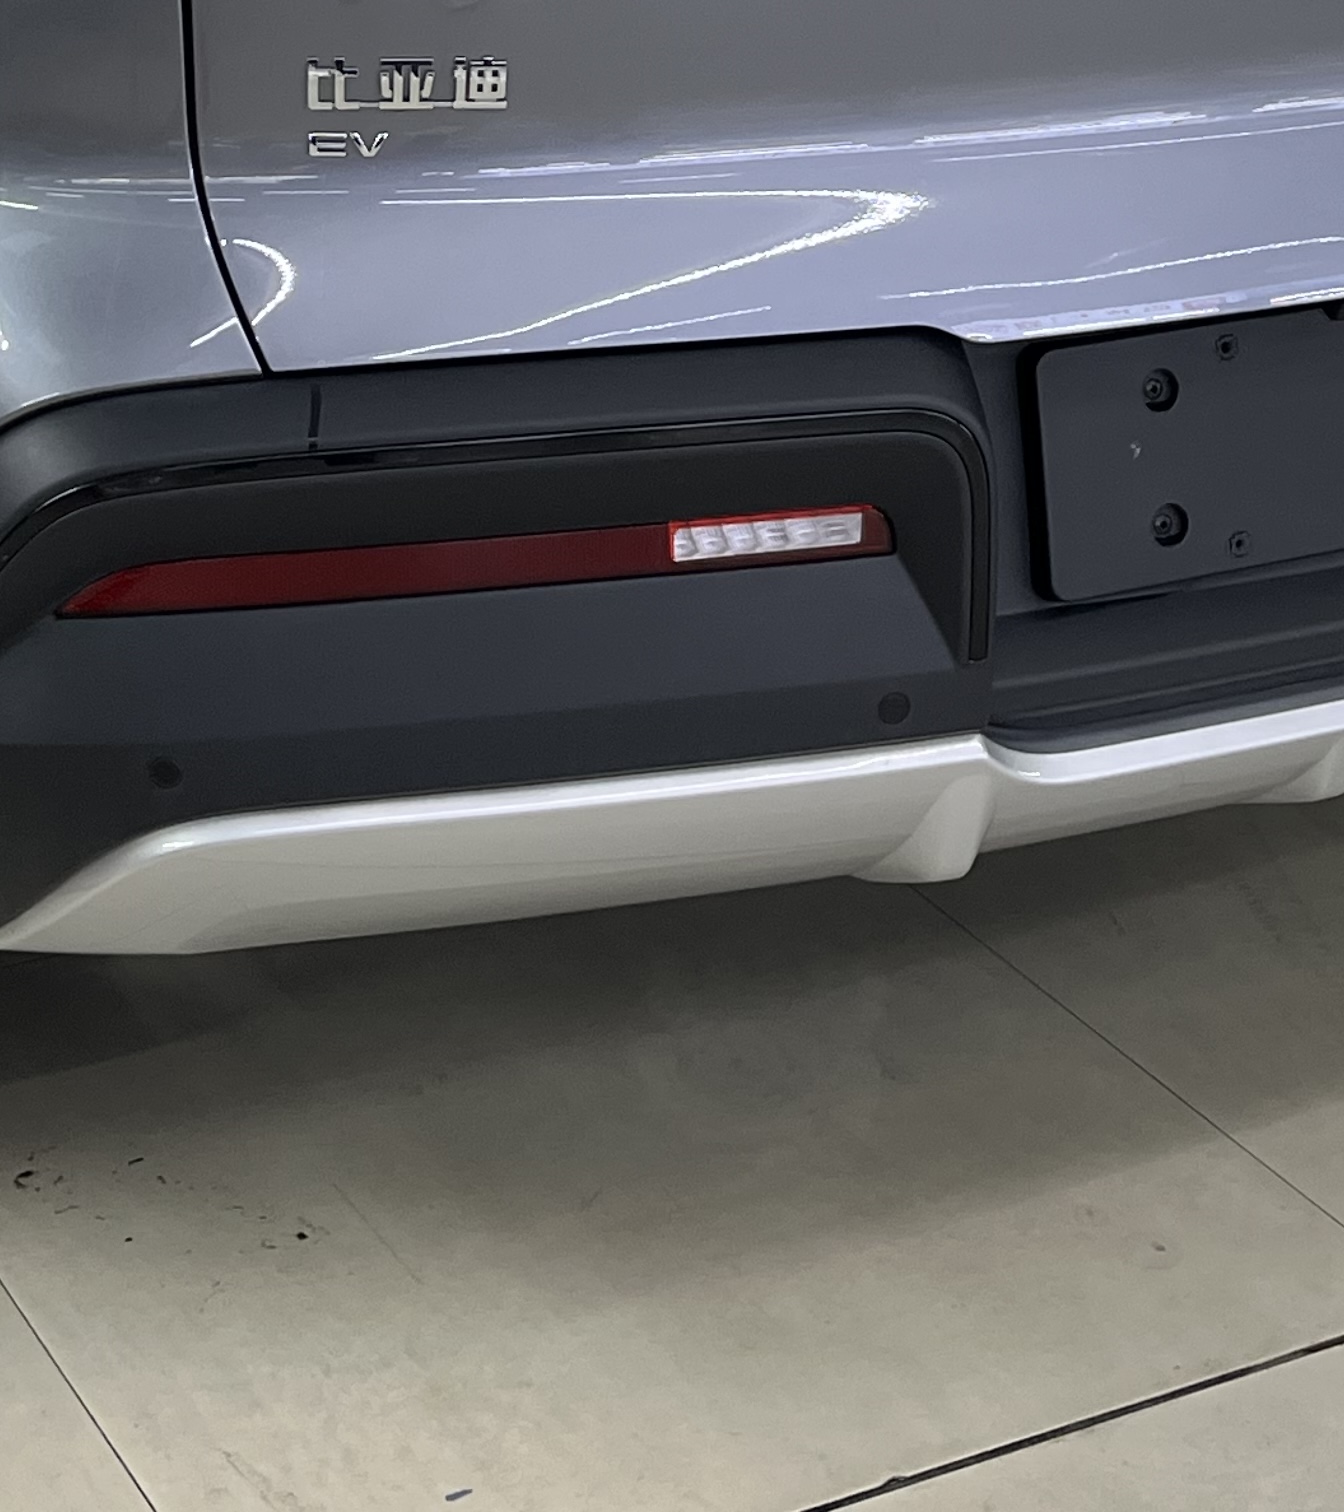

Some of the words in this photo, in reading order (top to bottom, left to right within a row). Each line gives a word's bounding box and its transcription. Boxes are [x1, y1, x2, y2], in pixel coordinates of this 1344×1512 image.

[307, 56, 508, 110] 比亚迪
[308, 132, 390, 157] EV
